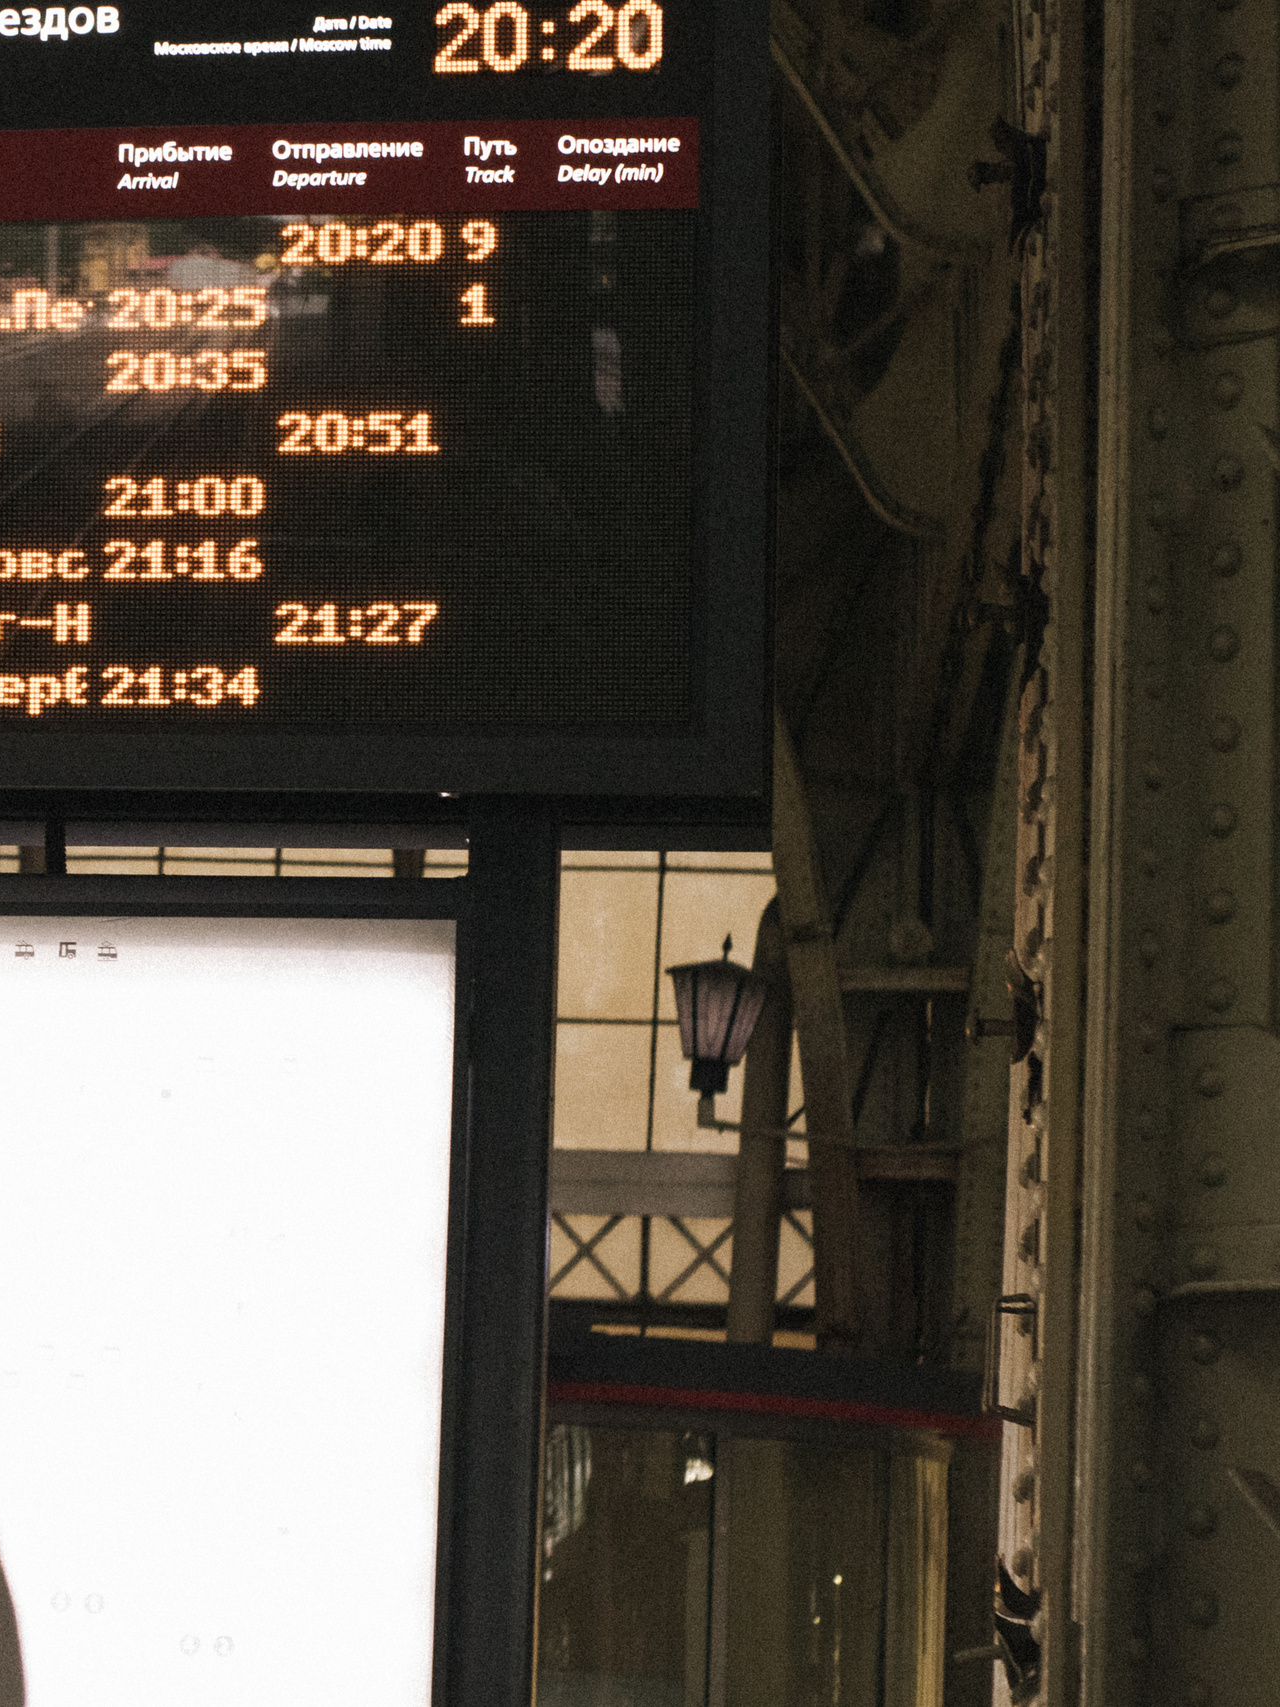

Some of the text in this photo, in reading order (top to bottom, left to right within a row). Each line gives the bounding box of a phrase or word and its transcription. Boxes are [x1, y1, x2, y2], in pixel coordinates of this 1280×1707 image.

[312, 16, 348, 33] Дата
[358, 15, 393, 31] Date
[433, 0, 664, 73] 20:20
[153, 41, 242, 57] Московское
[243, 40, 289, 57] время
[298, 37, 358, 53] Moscow
[358, 36, 392, 52] time
[118, 141, 233, 165] Прибытие
[271, 139, 424, 163] Отправление
[463, 136, 518, 162] Путь
[557, 134, 681, 157] Опоздание
[116, 171, 180, 190] Arrival
[271, 169, 368, 189] Departure
[464, 165, 516, 184] Track
[557, 162, 664, 186] Delay (min)
[281, 221, 444, 263] 20:20
[462, 221, 496, 260] 9
[107, 287, 267, 329] 20:25
[460, 285, 495, 325] 1
[106, 351, 268, 391] 20:35
[278, 411, 440, 453] 20:51
[103, 477, 265, 517] 21:00
[102, 540, 263, 580] 21:16
[273, 602, 439, 643] 21:27
[100, 666, 261, 706] 21:34
